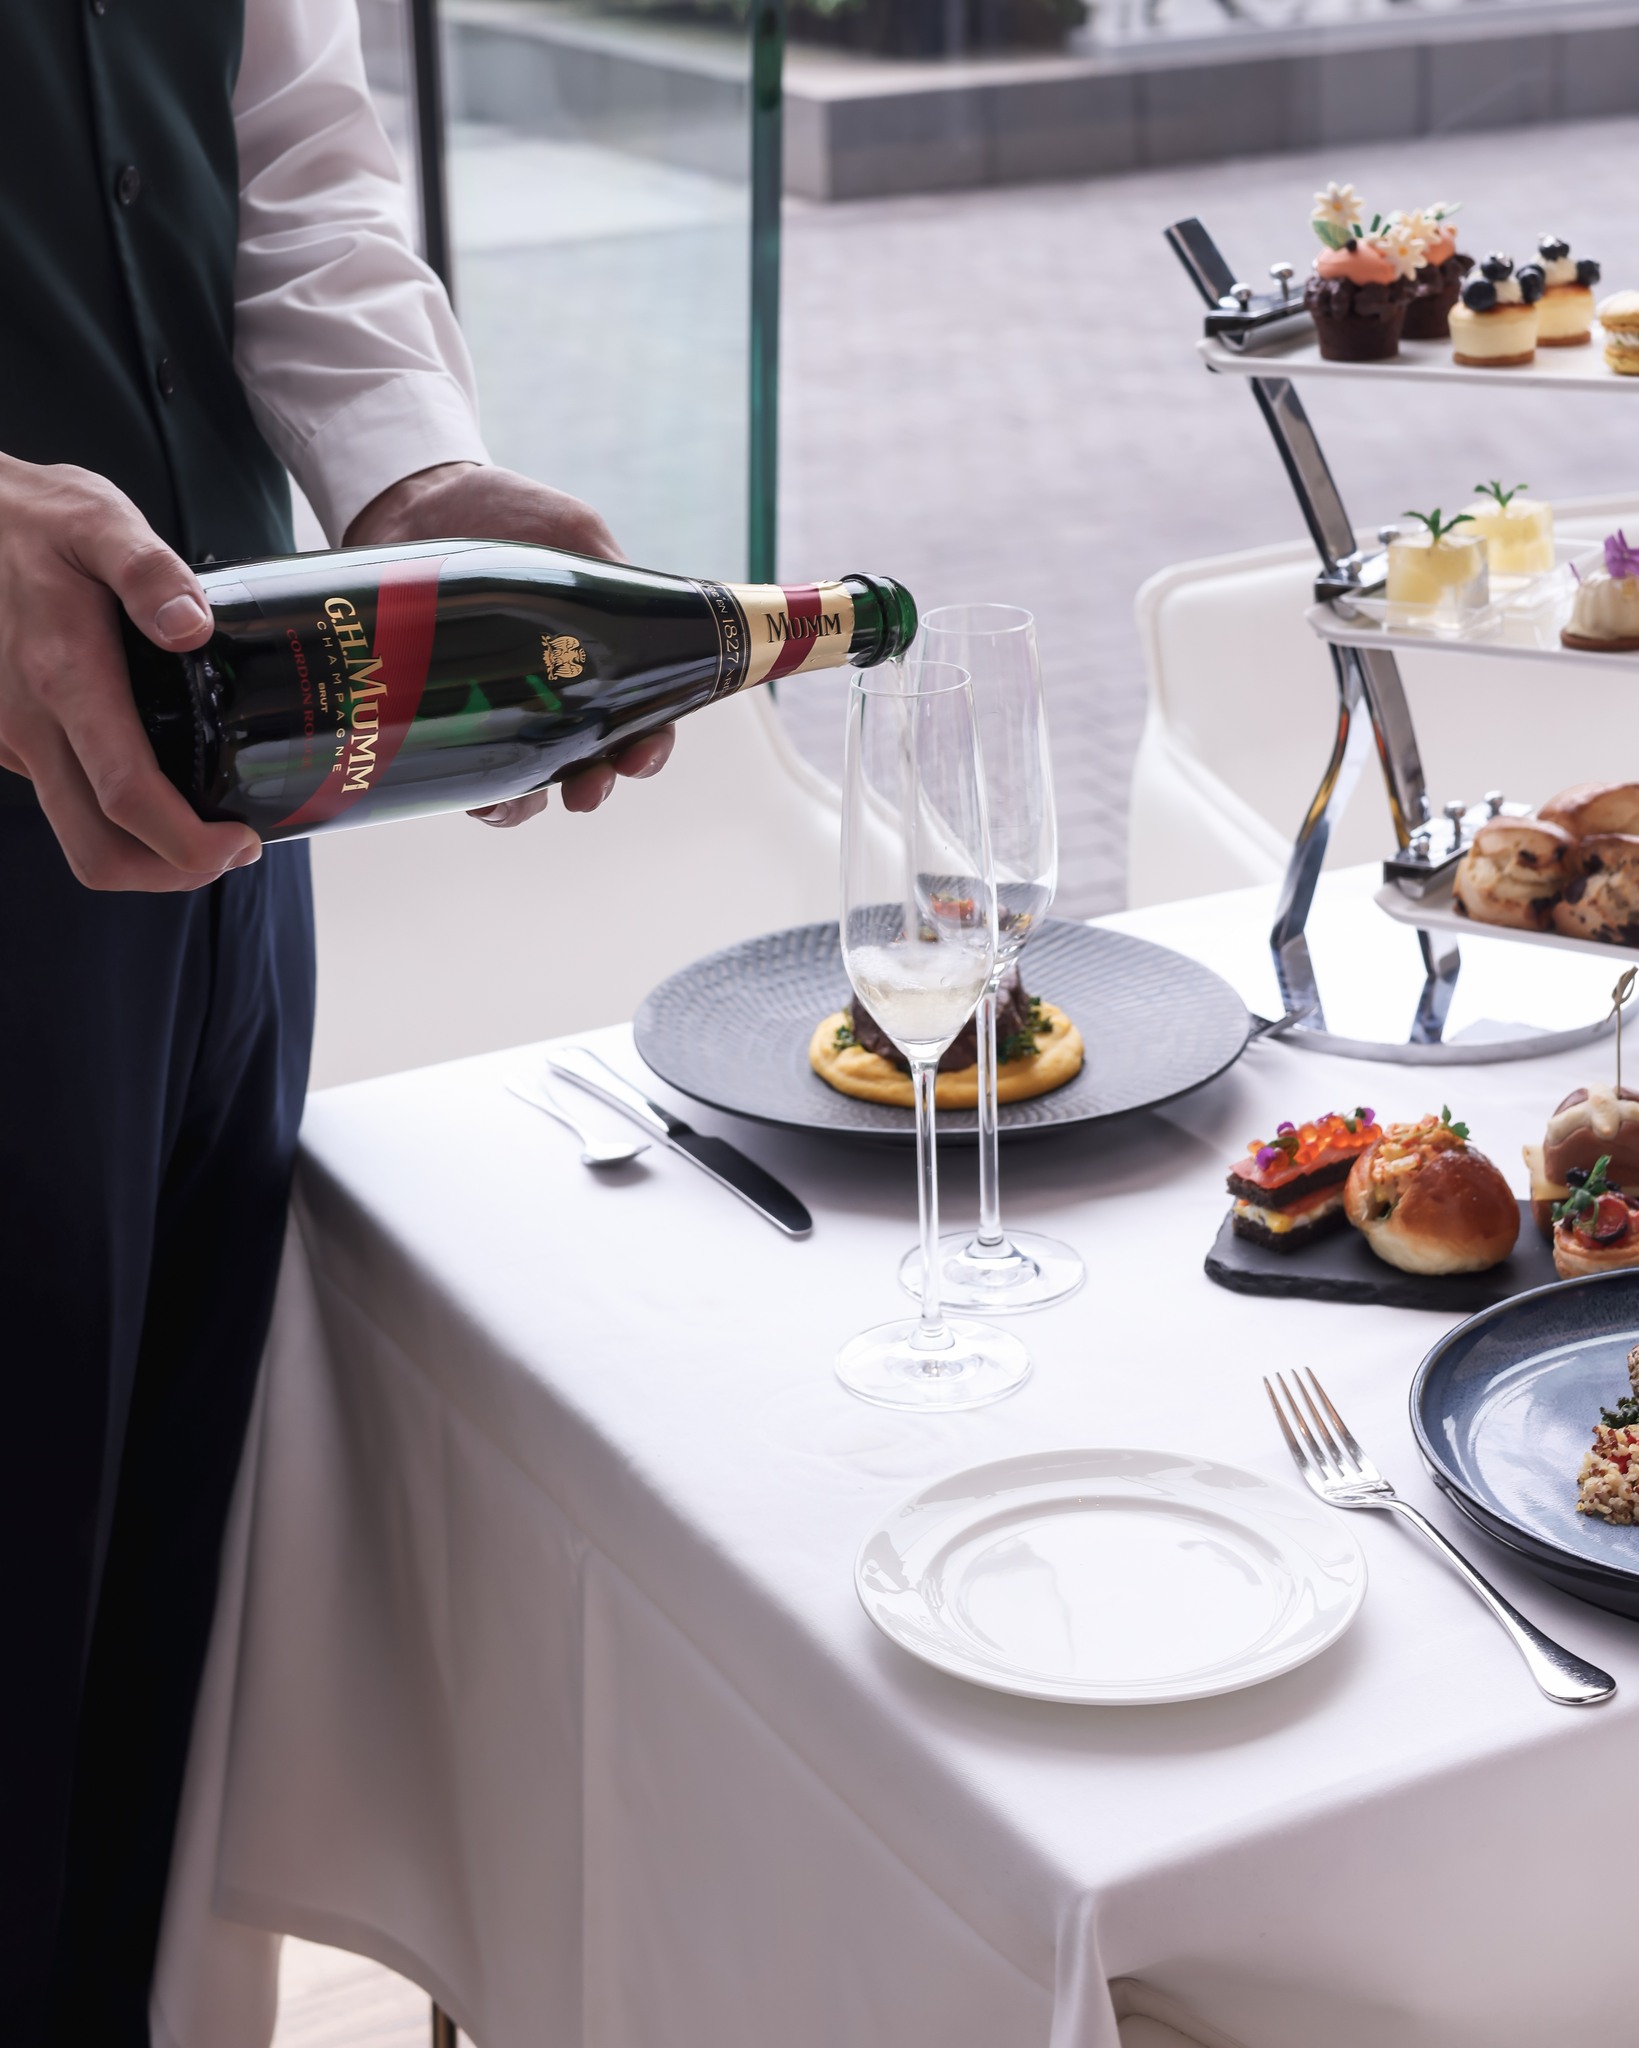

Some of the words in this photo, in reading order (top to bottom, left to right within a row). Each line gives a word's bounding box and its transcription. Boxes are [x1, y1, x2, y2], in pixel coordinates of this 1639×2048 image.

[722, 619, 739, 664] 1827
[764, 611, 842, 643] MUMM
[286, 629, 312, 704] CORDON
[317, 620, 346, 773] CHAMPAGNE
[318, 682, 328, 713] BRUT
